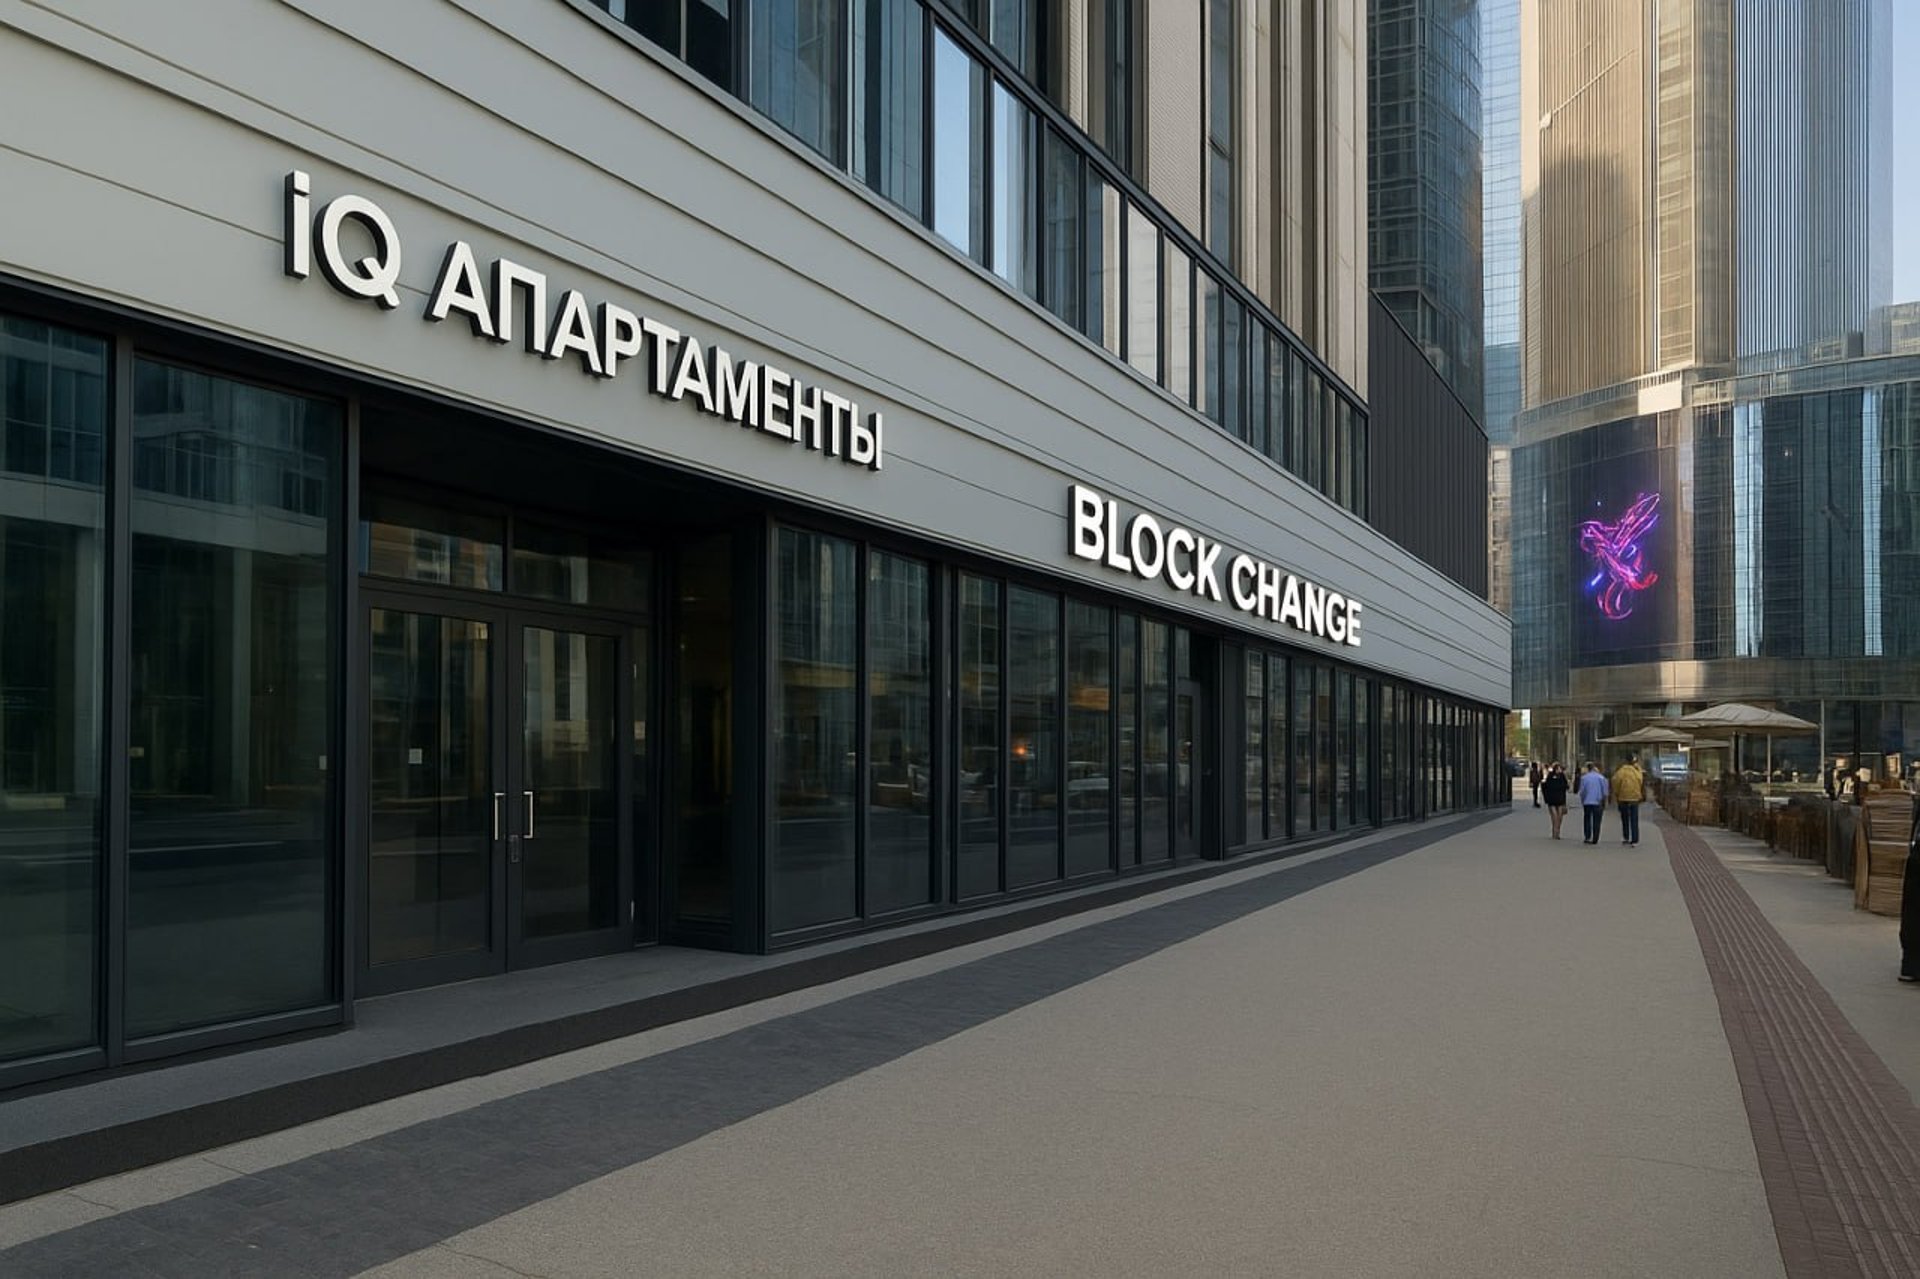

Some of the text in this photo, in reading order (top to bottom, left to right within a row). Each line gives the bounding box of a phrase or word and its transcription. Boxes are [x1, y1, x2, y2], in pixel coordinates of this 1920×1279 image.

[287, 170, 883, 471] iQ АПАРТАМЕНТЫ
[1069, 484, 1362, 647] BLOCK CHANGE
